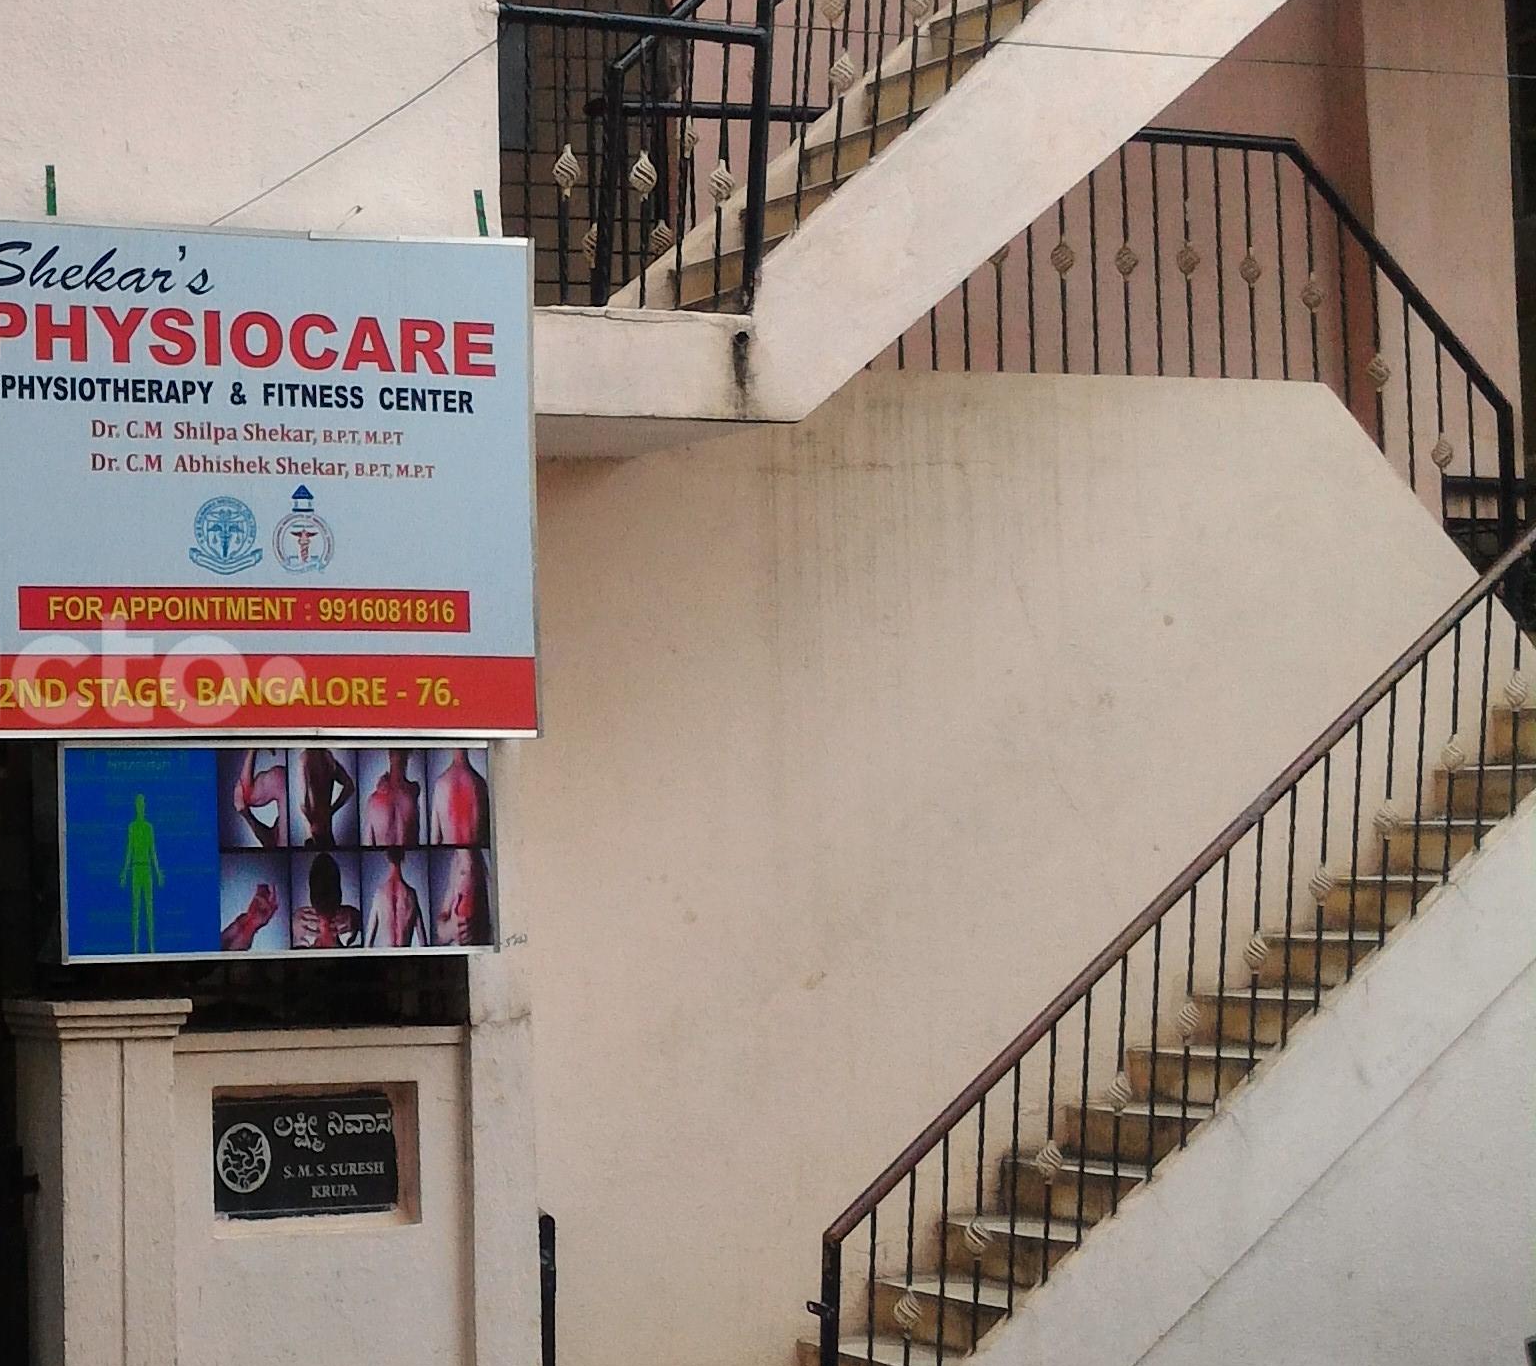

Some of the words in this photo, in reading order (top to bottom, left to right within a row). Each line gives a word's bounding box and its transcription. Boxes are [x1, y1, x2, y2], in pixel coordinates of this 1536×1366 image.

[1, 375, 213, 405] PHYSIOTHERAPY
[231, 382, 247, 405] &
[263, 383, 364, 410] FITNESS
[379, 386, 474, 413] CENTER
[91, 420, 120, 438] Dr.
[126, 420, 162, 439] C.M
[173, 421, 237, 445] Shilpa
[243, 423, 317, 446] Shekar,
[91, 453, 120, 472] Dr.
[126, 453, 162, 472] C.M
[173, 454, 271, 475] Abhishek
[276, 456, 349, 478] Shekar,
[48, 596, 103, 621] FOR
[110, 597, 296, 622] APPOINTMENT
[319, 600, 456, 623] 9916081816
[76, 678, 188, 715] STAGE,
[197, 676, 388, 709] BANGALORE
[416, 677, 461, 709] 76.
[331, 1161, 384, 1177] SURESH
[312, 1185, 358, 1198] KRUPA
